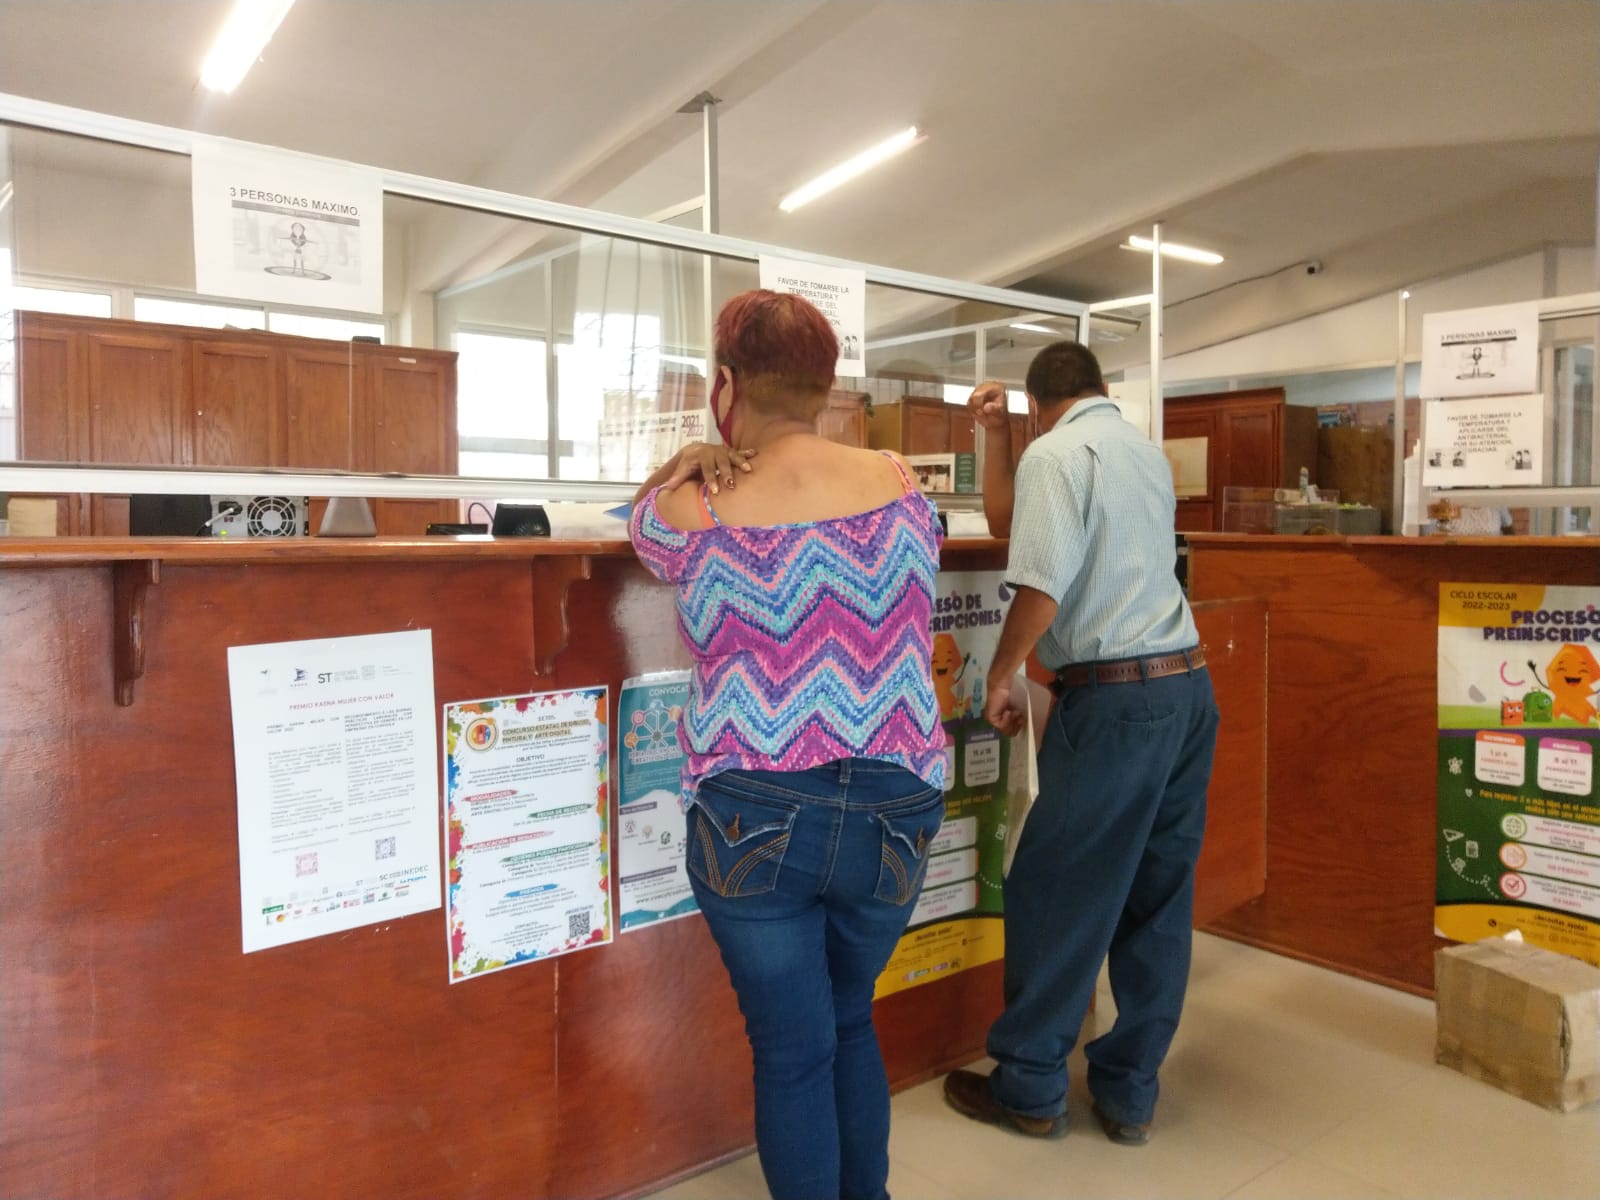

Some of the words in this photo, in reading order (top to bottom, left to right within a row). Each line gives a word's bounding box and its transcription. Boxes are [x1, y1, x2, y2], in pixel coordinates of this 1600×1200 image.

[229, 187, 237, 198] 3
[240, 188, 308, 208] PERSONAS
[777, 276, 799, 287] FAVOR
[800, 280, 809, 288] DE
[810, 281, 839, 293] TOMARSE
[840, 285, 849, 294] LA
[1446, 330, 1485, 341] PERSONAS
[681, 414, 700, 428] 2021
[966, 593, 982, 610] DE
[1450, 590, 1475, 600] CICLO
[1477, 591, 1518, 601] ESCOLAR
[1462, 601, 1511, 611] 2022-2023
[1511, 609, 1600, 625] PROCESO
[318, 672, 333, 684] ST
[649, 685, 689, 697] CONVOCAT
[289, 702, 313, 711] PREMIO
[502, 726, 535, 736] CONCURSO
